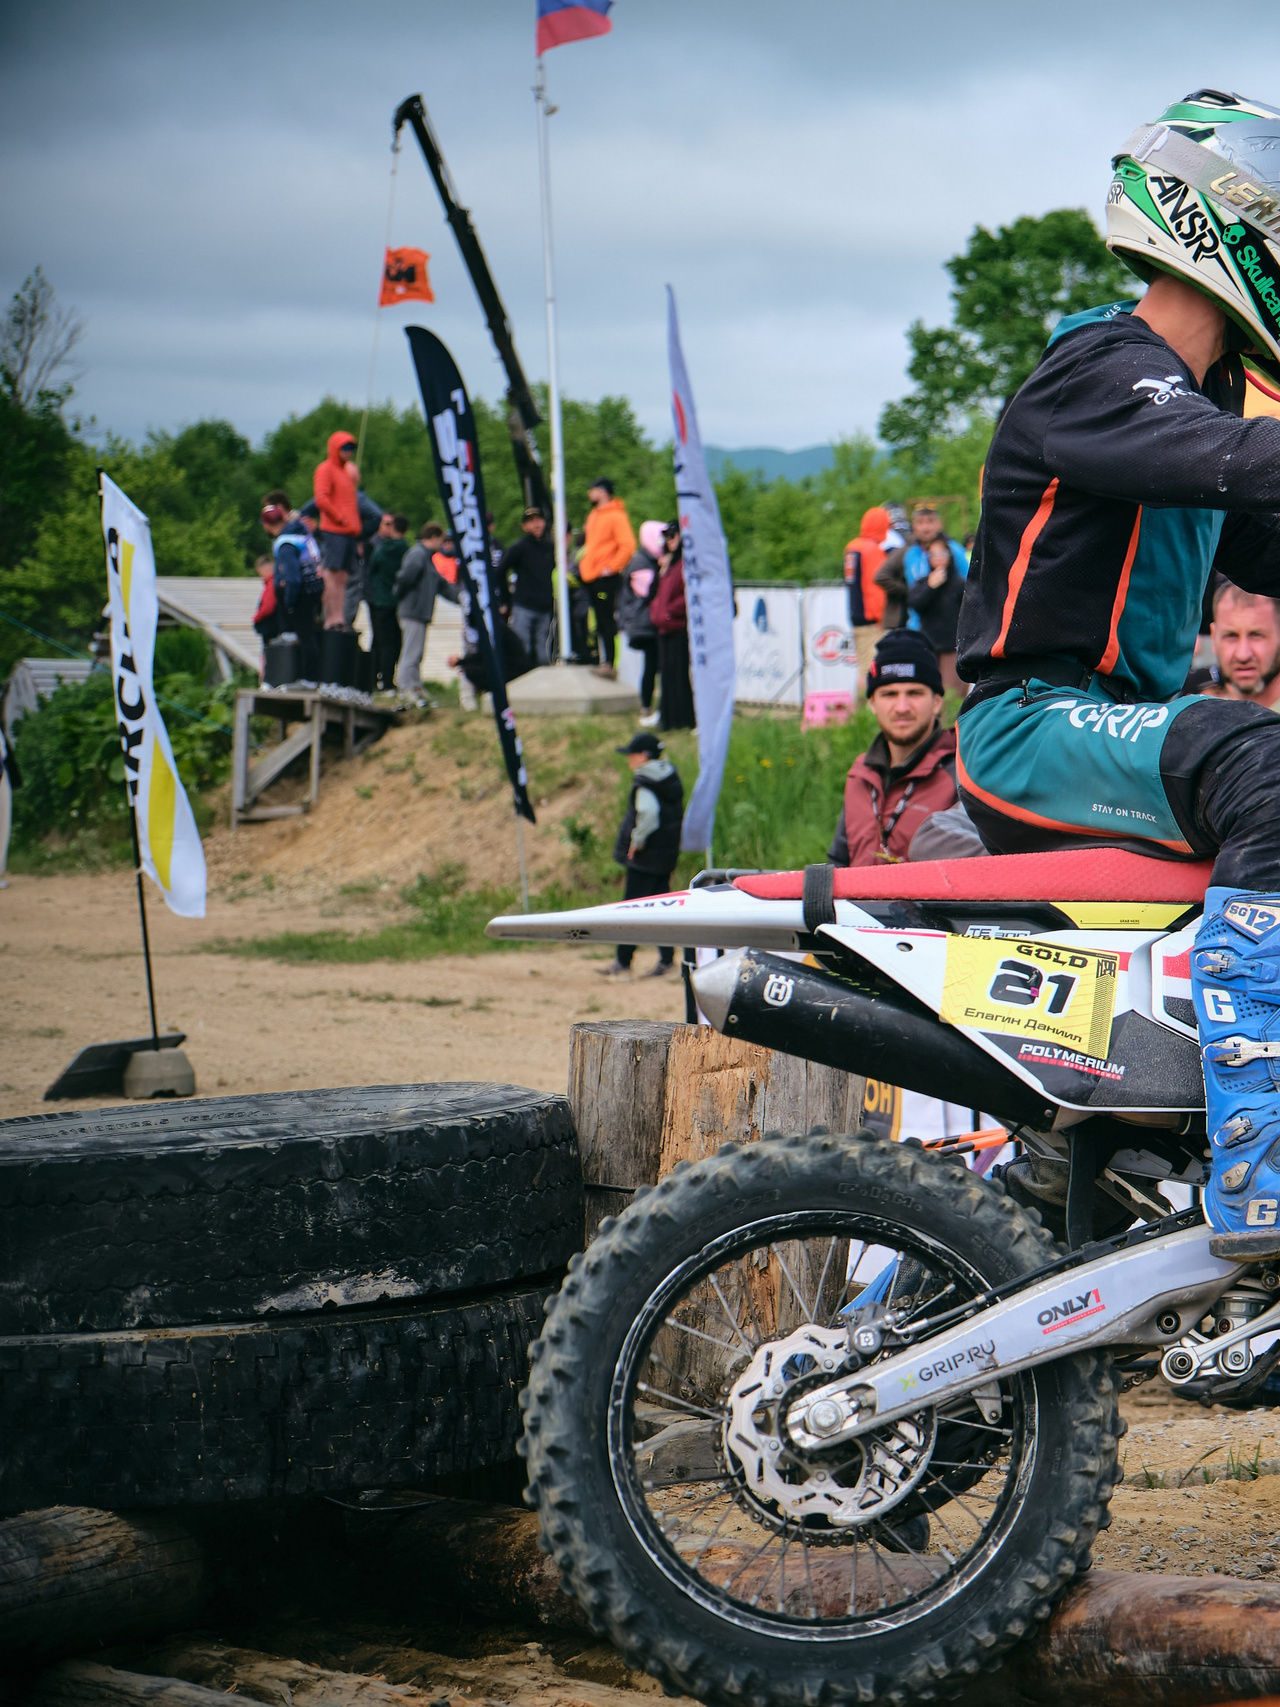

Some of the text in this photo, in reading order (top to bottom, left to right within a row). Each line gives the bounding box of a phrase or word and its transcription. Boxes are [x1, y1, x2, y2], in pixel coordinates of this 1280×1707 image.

[1149, 175, 1220, 264] ANSR
[1092, 803, 1158, 823] STAY ON TRACK
[1016, 943, 1089, 968] GOLD
[989, 958, 1077, 1015] 21
[963, 1007, 1082, 1043] Елагин Даниил
[1019, 1043, 1126, 1075] POLYMERIUM
[1063, 1061, 1089, 1072] MOTOR
[1036, 1287, 1102, 1326] ONLY1
